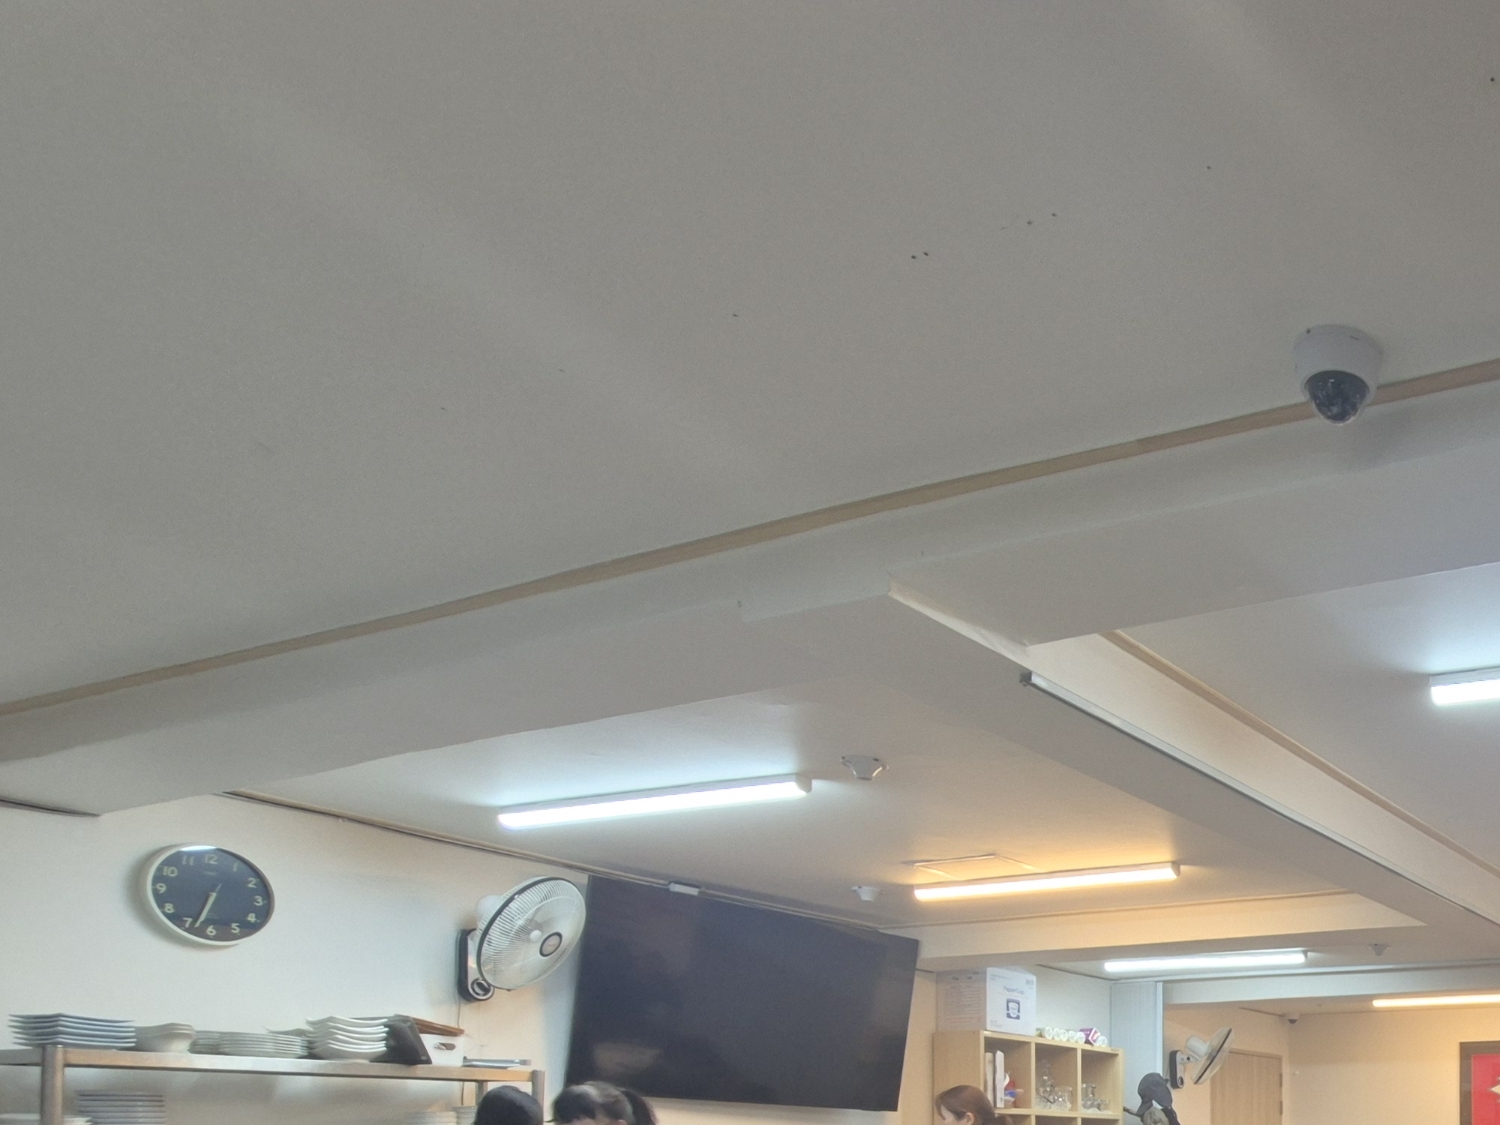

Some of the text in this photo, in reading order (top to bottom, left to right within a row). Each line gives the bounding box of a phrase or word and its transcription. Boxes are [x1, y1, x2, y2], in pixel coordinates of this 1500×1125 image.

[204, 854, 218, 865] 12
[163, 866, 178, 877] 10
[156, 883, 167, 893] 9
[247, 877, 257, 888] 2
[254, 895, 263, 906] 3
[164, 903, 175, 913] 8
[183, 917, 193, 928] 7
[246, 913, 256, 923] 4
[206, 925, 217, 936] 6
[231, 923, 240, 933] 5
